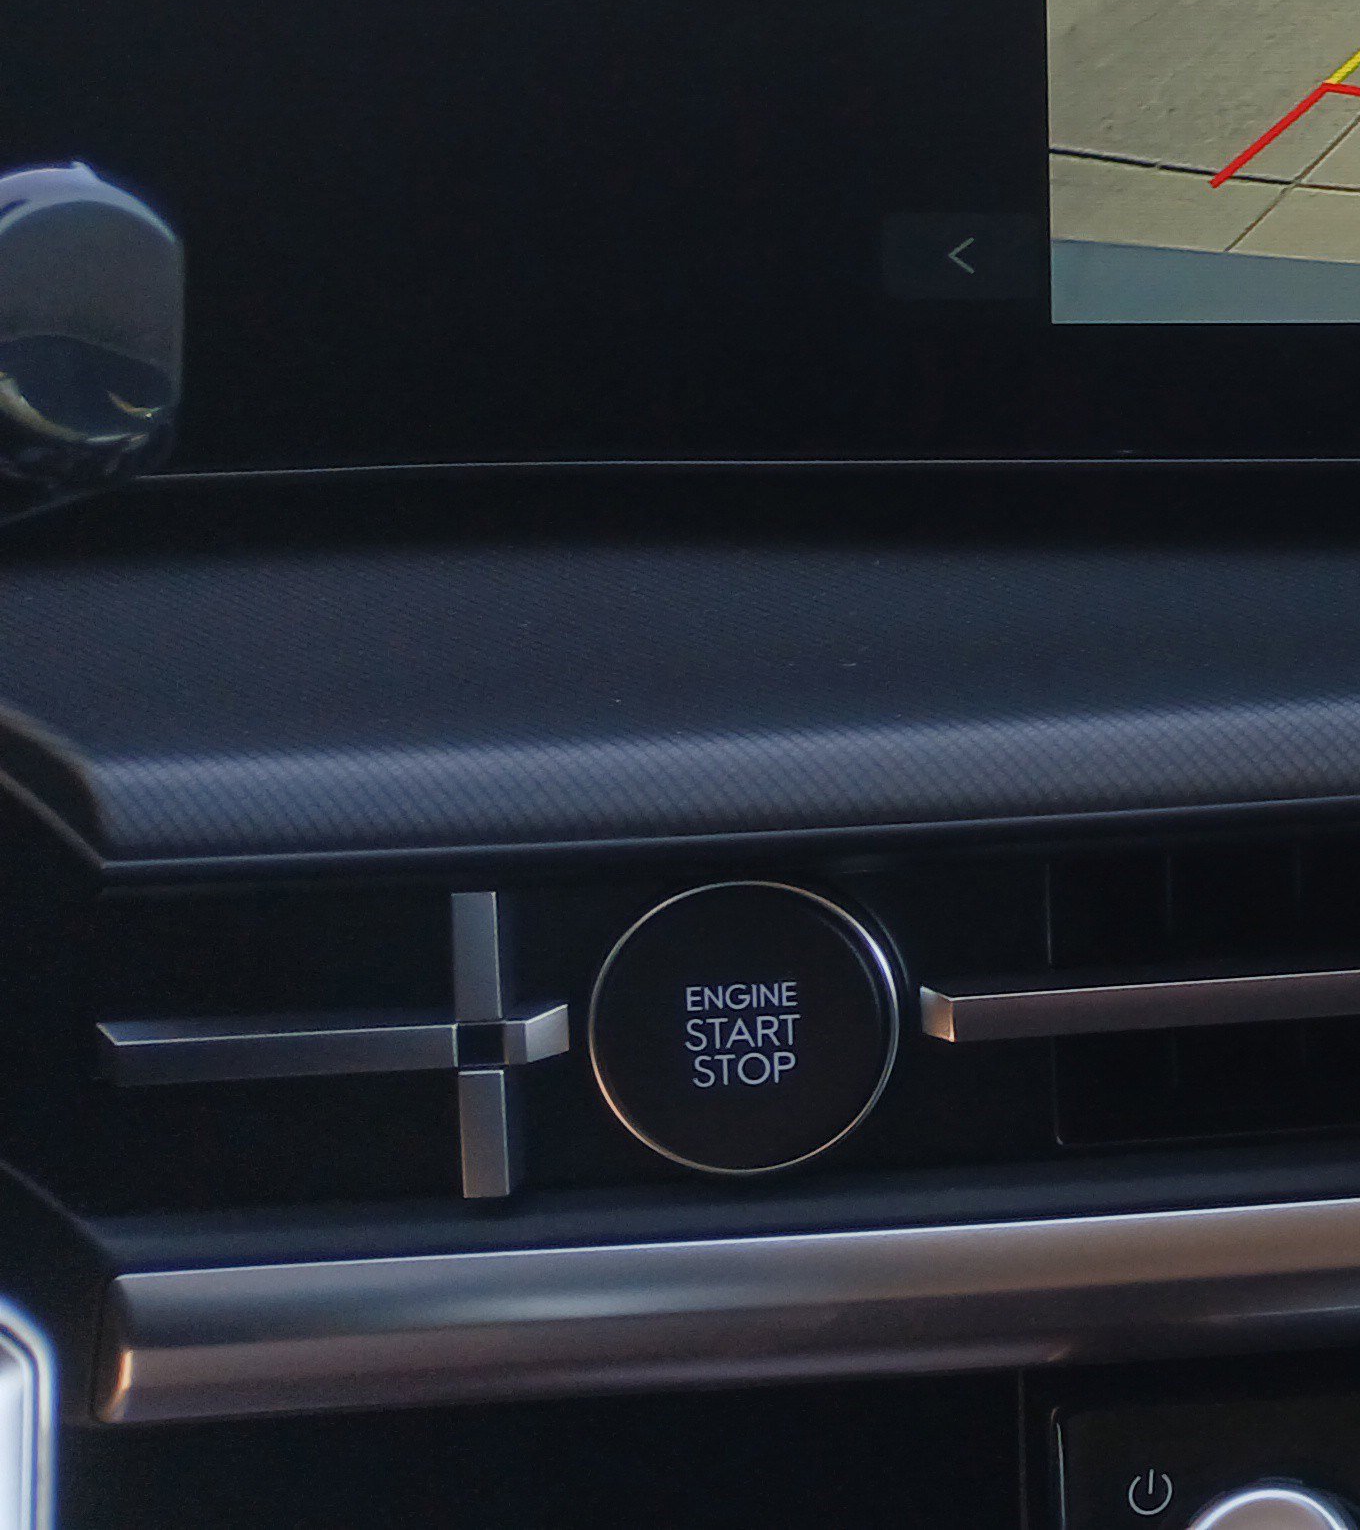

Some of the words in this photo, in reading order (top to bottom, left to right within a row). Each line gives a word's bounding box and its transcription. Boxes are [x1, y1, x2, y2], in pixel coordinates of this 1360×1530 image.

[685, 981, 799, 1012] ENGINE
[685, 1013, 802, 1052] START
[692, 1051, 796, 1088] STOP
